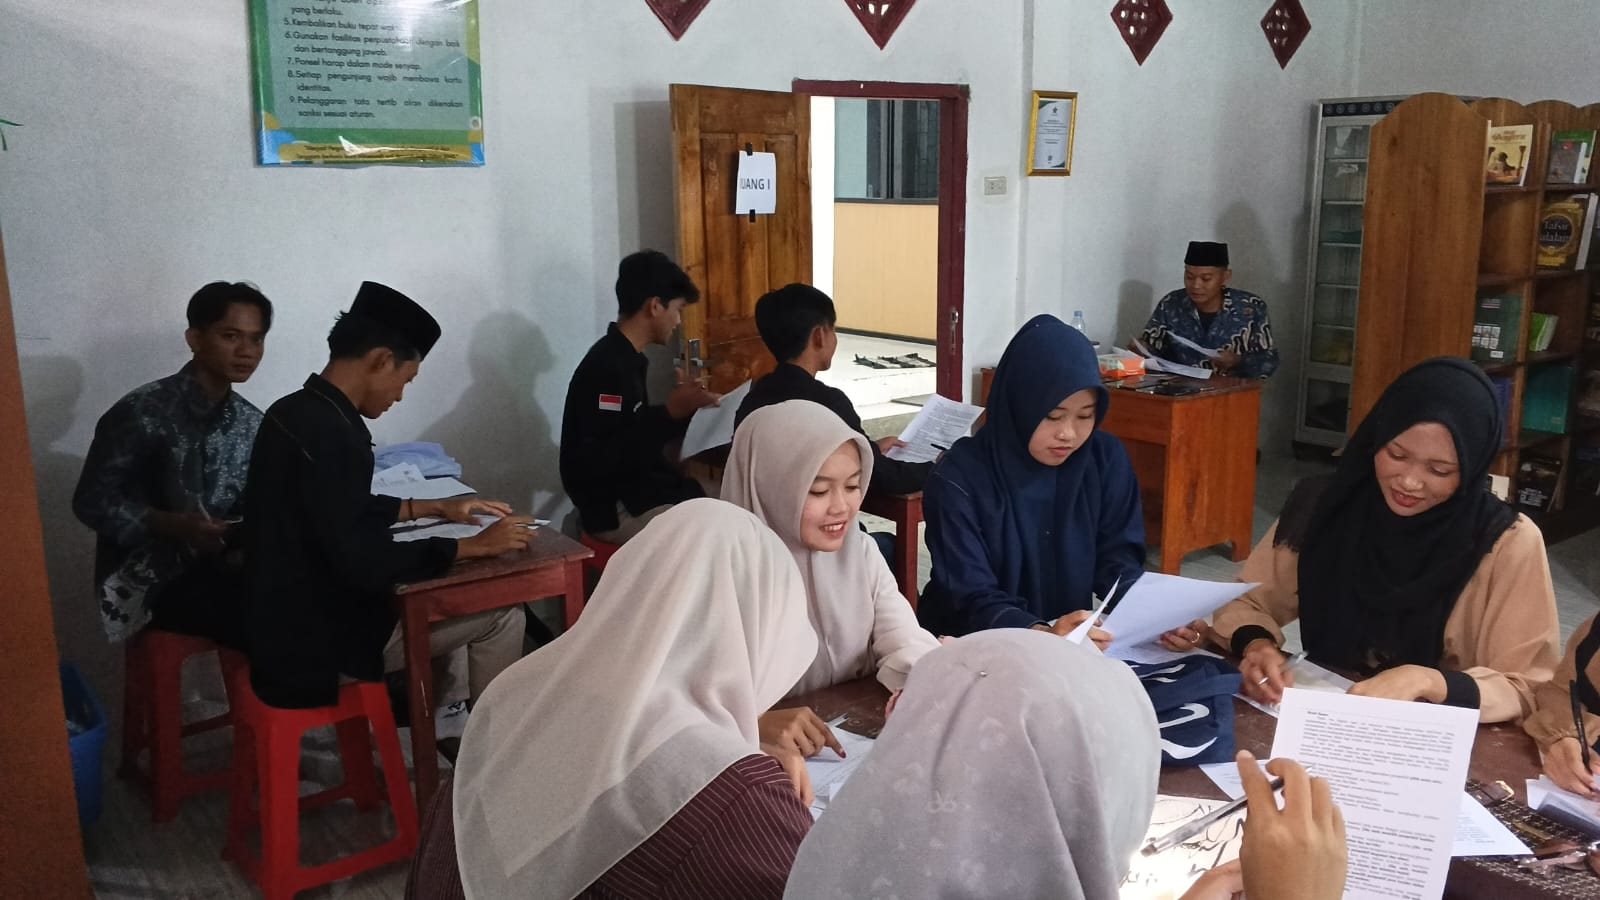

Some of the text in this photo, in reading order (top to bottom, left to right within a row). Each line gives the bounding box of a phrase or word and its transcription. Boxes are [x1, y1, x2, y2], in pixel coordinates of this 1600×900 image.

[338, 20, 356, 29] buku
[294, 44, 310, 53] dan
[311, 45, 361, 57] bertanggung
[321, 58, 345, 68] harap
[346, 59, 370, 68] dalam
[372, 61, 393, 69] mode
[327, 73, 372, 82] pengunjung
[377, 72, 397, 83] wajib
[402, 74, 440, 83] membawa
[740, 178, 765, 190] UANG
